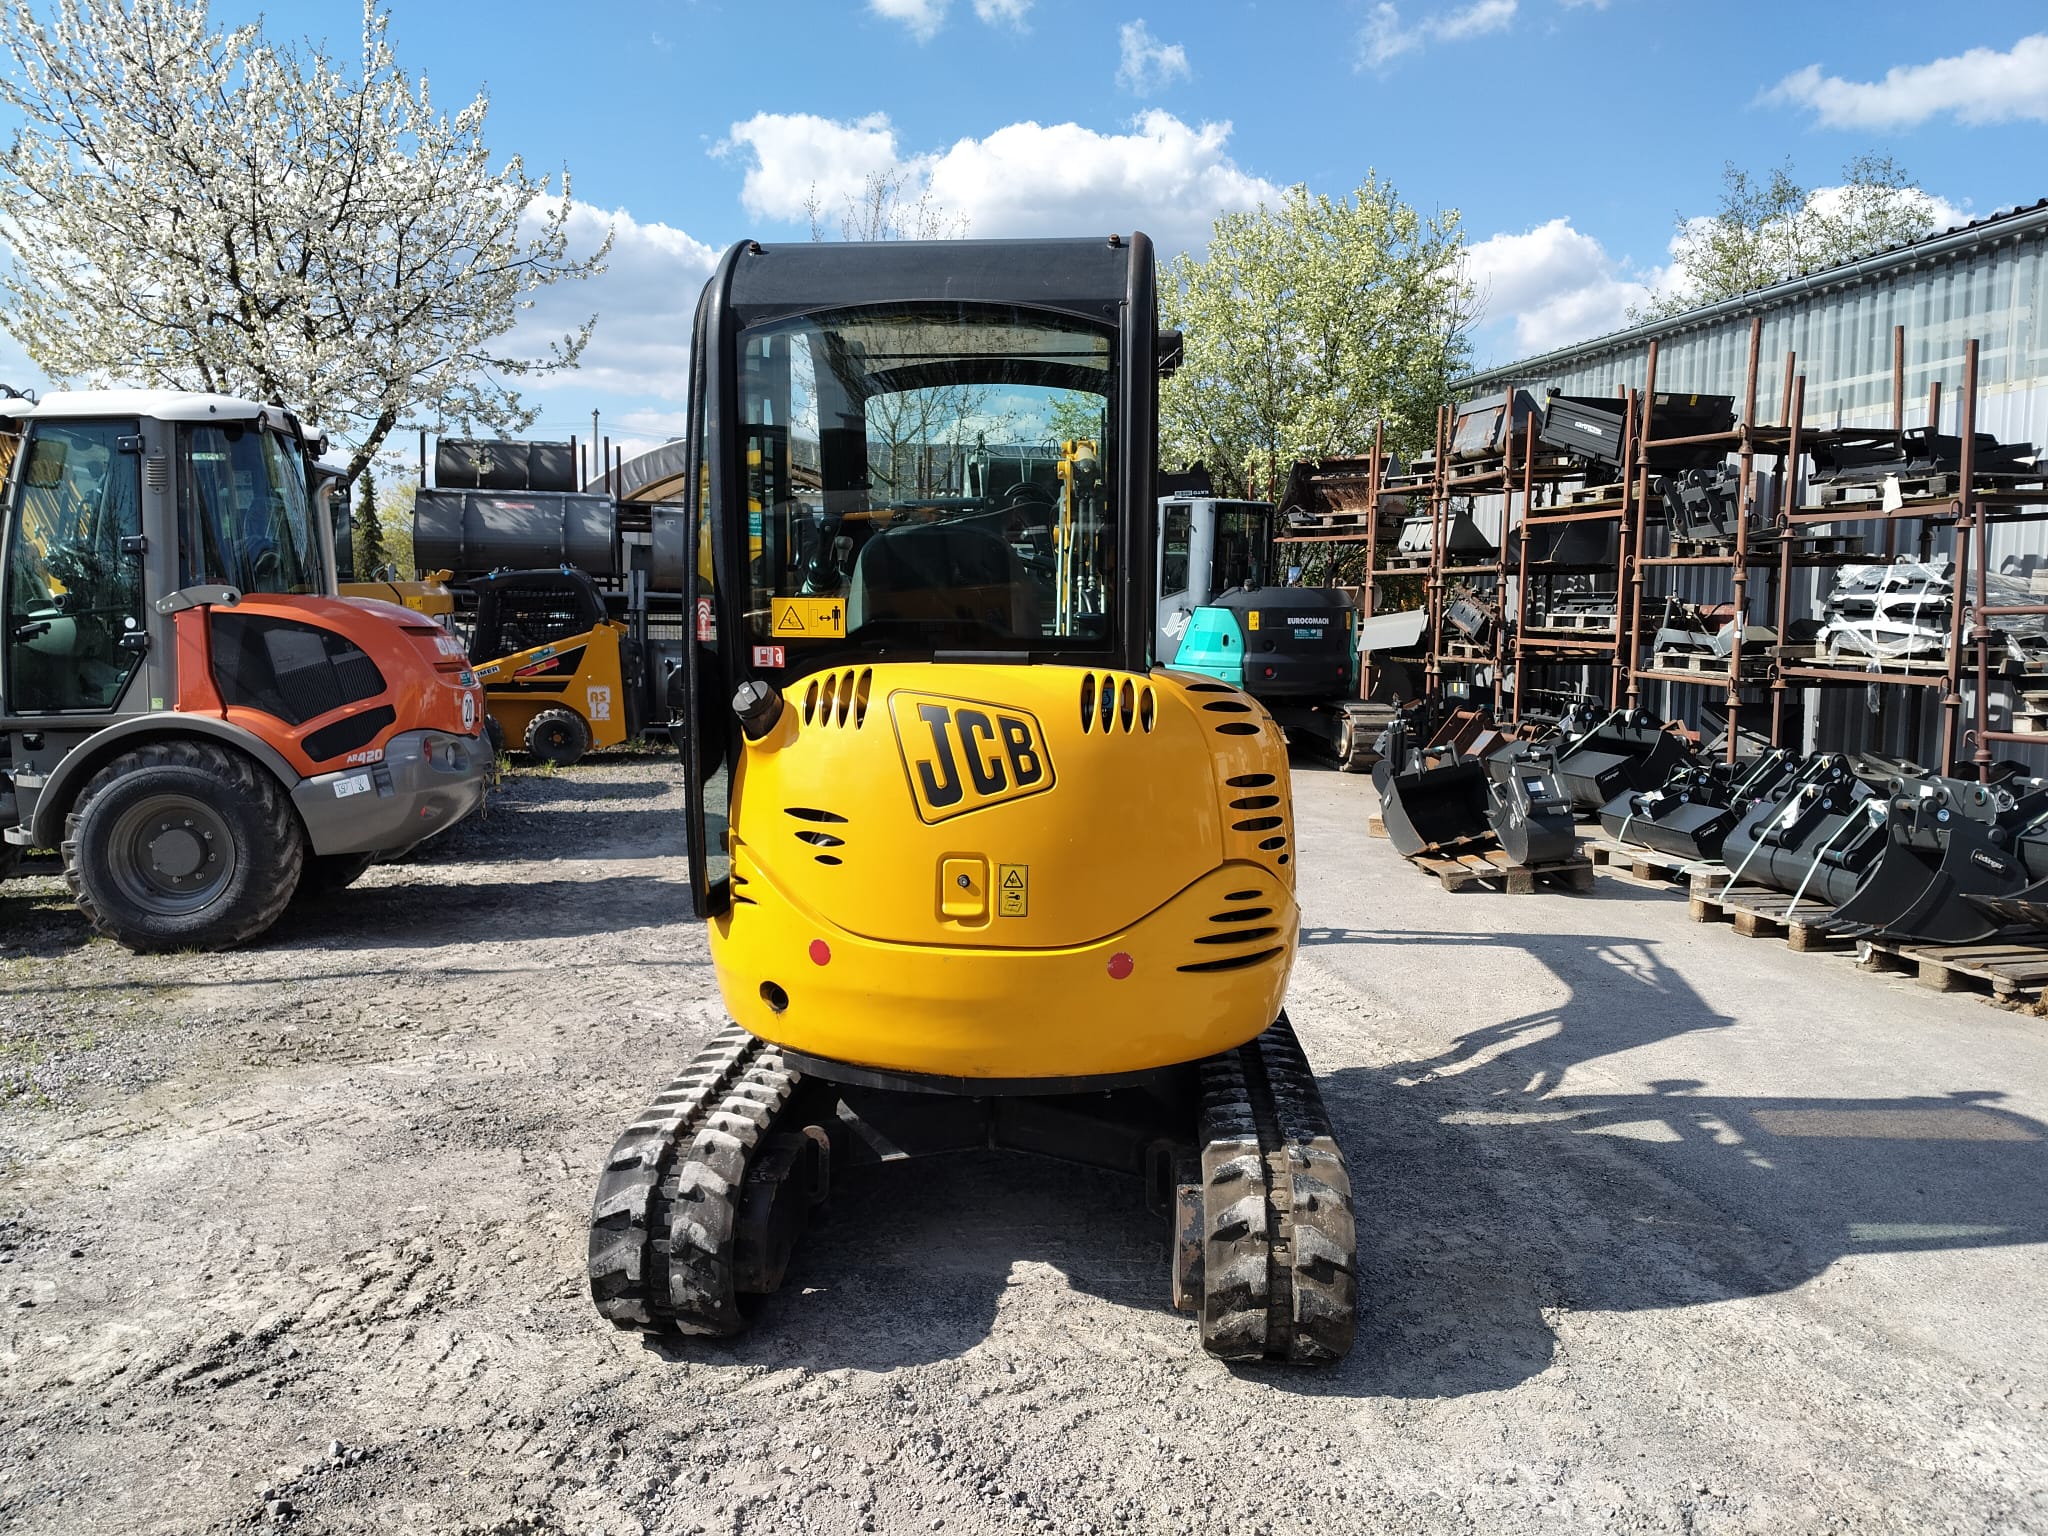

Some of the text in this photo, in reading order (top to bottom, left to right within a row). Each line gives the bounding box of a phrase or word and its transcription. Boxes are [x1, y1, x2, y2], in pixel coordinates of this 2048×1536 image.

[588, 702, 610, 721] 12
[347, 748, 383, 764] AR420
[917, 702, 1043, 808] JCB
